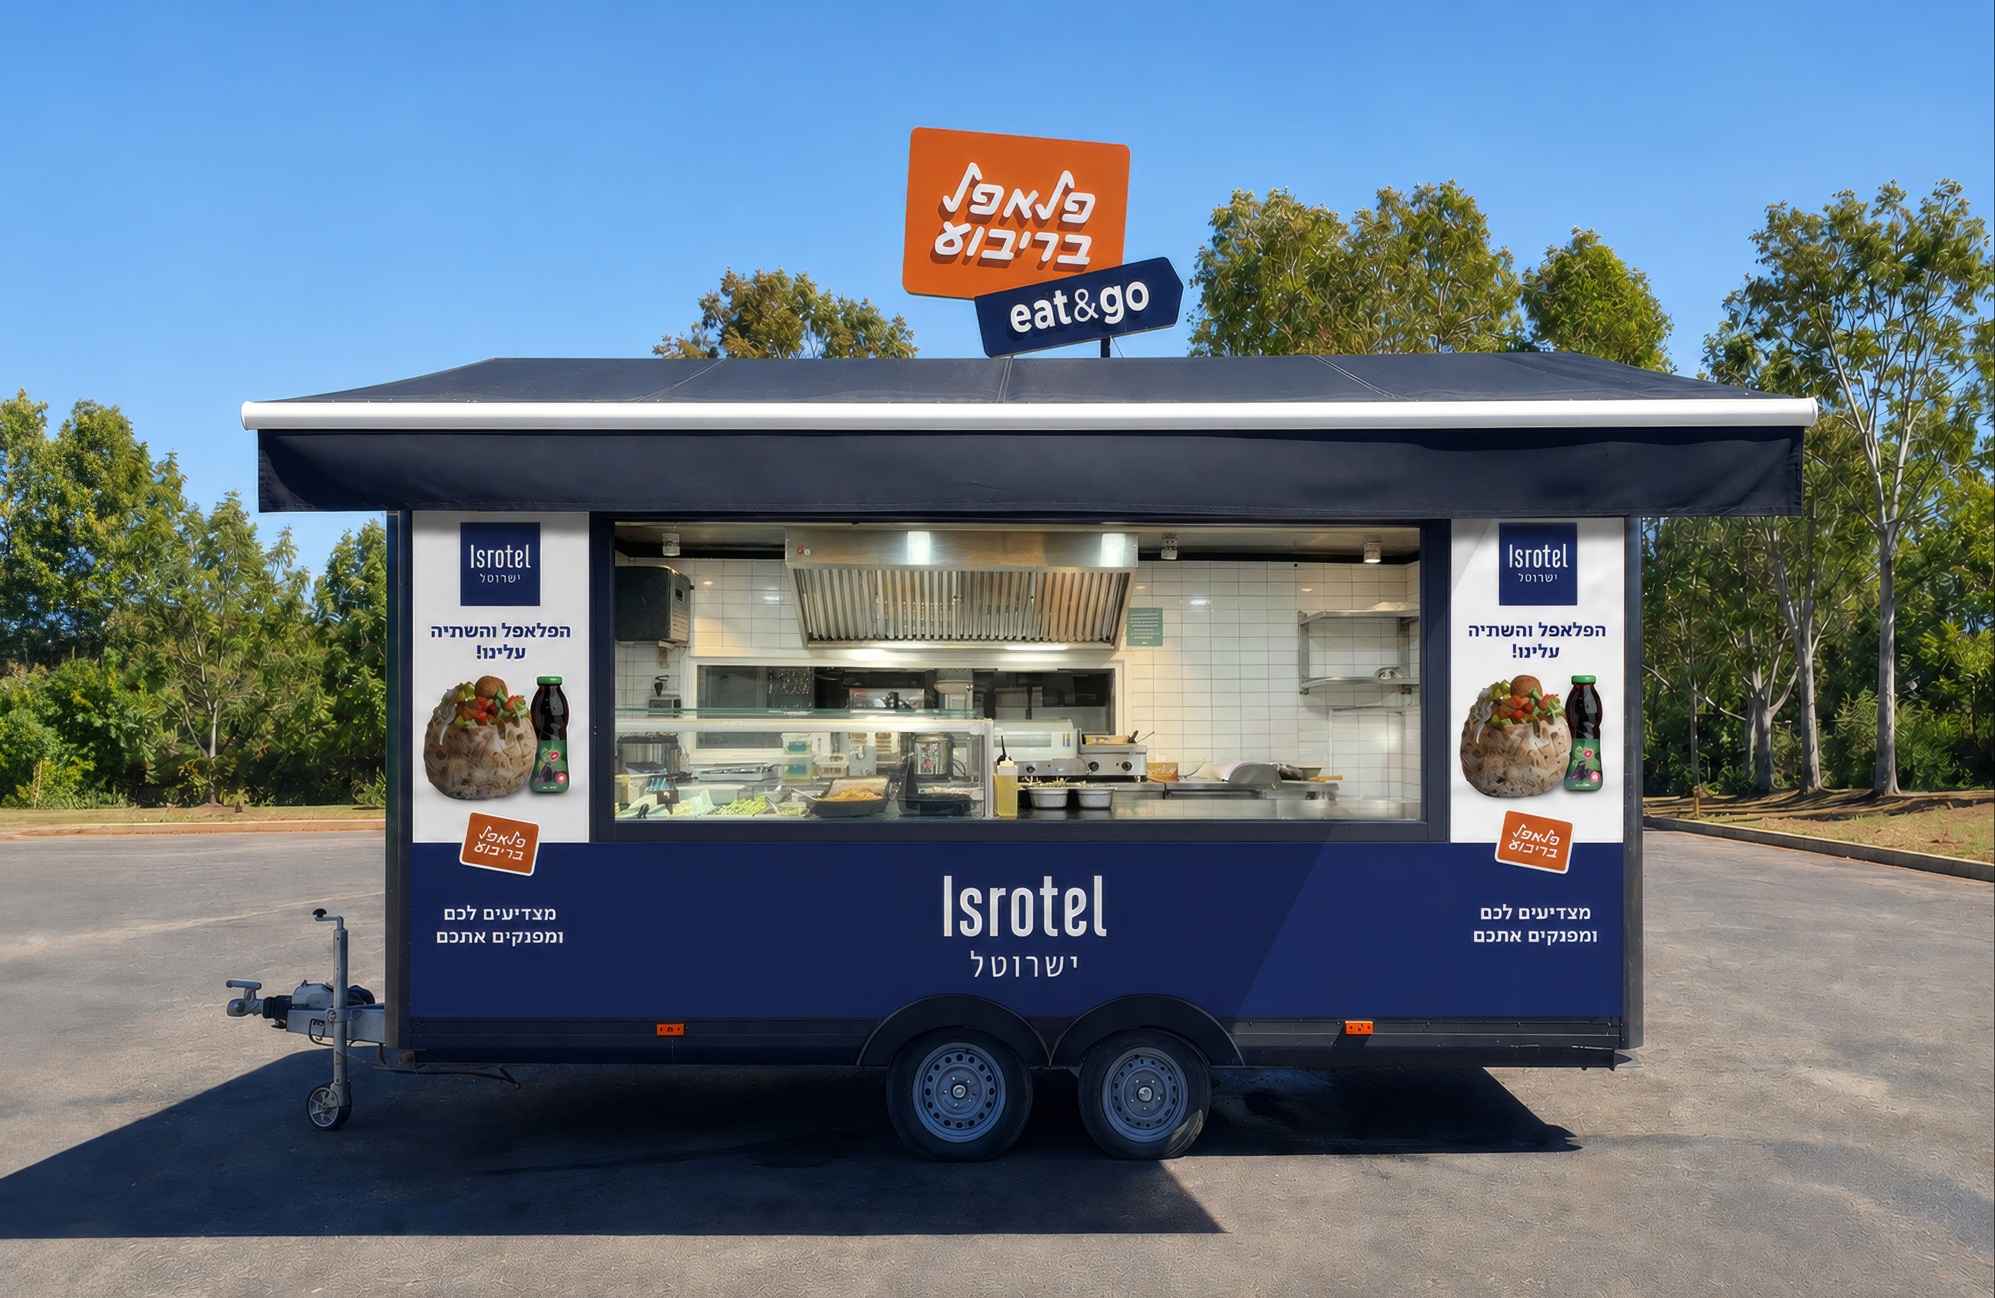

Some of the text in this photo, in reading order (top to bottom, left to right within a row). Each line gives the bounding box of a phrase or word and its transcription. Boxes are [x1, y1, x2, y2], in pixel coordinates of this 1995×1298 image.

[942, 162, 1096, 224] פלאפל
[934, 221, 1092, 265] בריבוע
[1010, 281, 1150, 333] eat&go
[470, 544, 531, 569] Isrotel
[1509, 543, 1569, 569] Isrotel
[430, 622, 571, 638] הפלאפל והשתיה
[1468, 621, 1606, 638] הפלאפל והשתיה
[476, 644, 526, 660] עלינו!
[1512, 643, 1560, 659] עלינו!
[478, 825, 527, 849] פלאפל
[1512, 823, 1560, 846] פלאפל
[473, 841, 524, 861] בריבוע
[444, 904, 557, 921] מצדיעים לכם
[943, 875, 1107, 937] Isrotel
[1480, 903, 1591, 920] מצדיעים לכם
[436, 931, 564, 947] ומפנקים אתכם
[1473, 930, 1598, 946] ומפנקים אתכם
[970, 950, 1079, 978] ישרוטל
